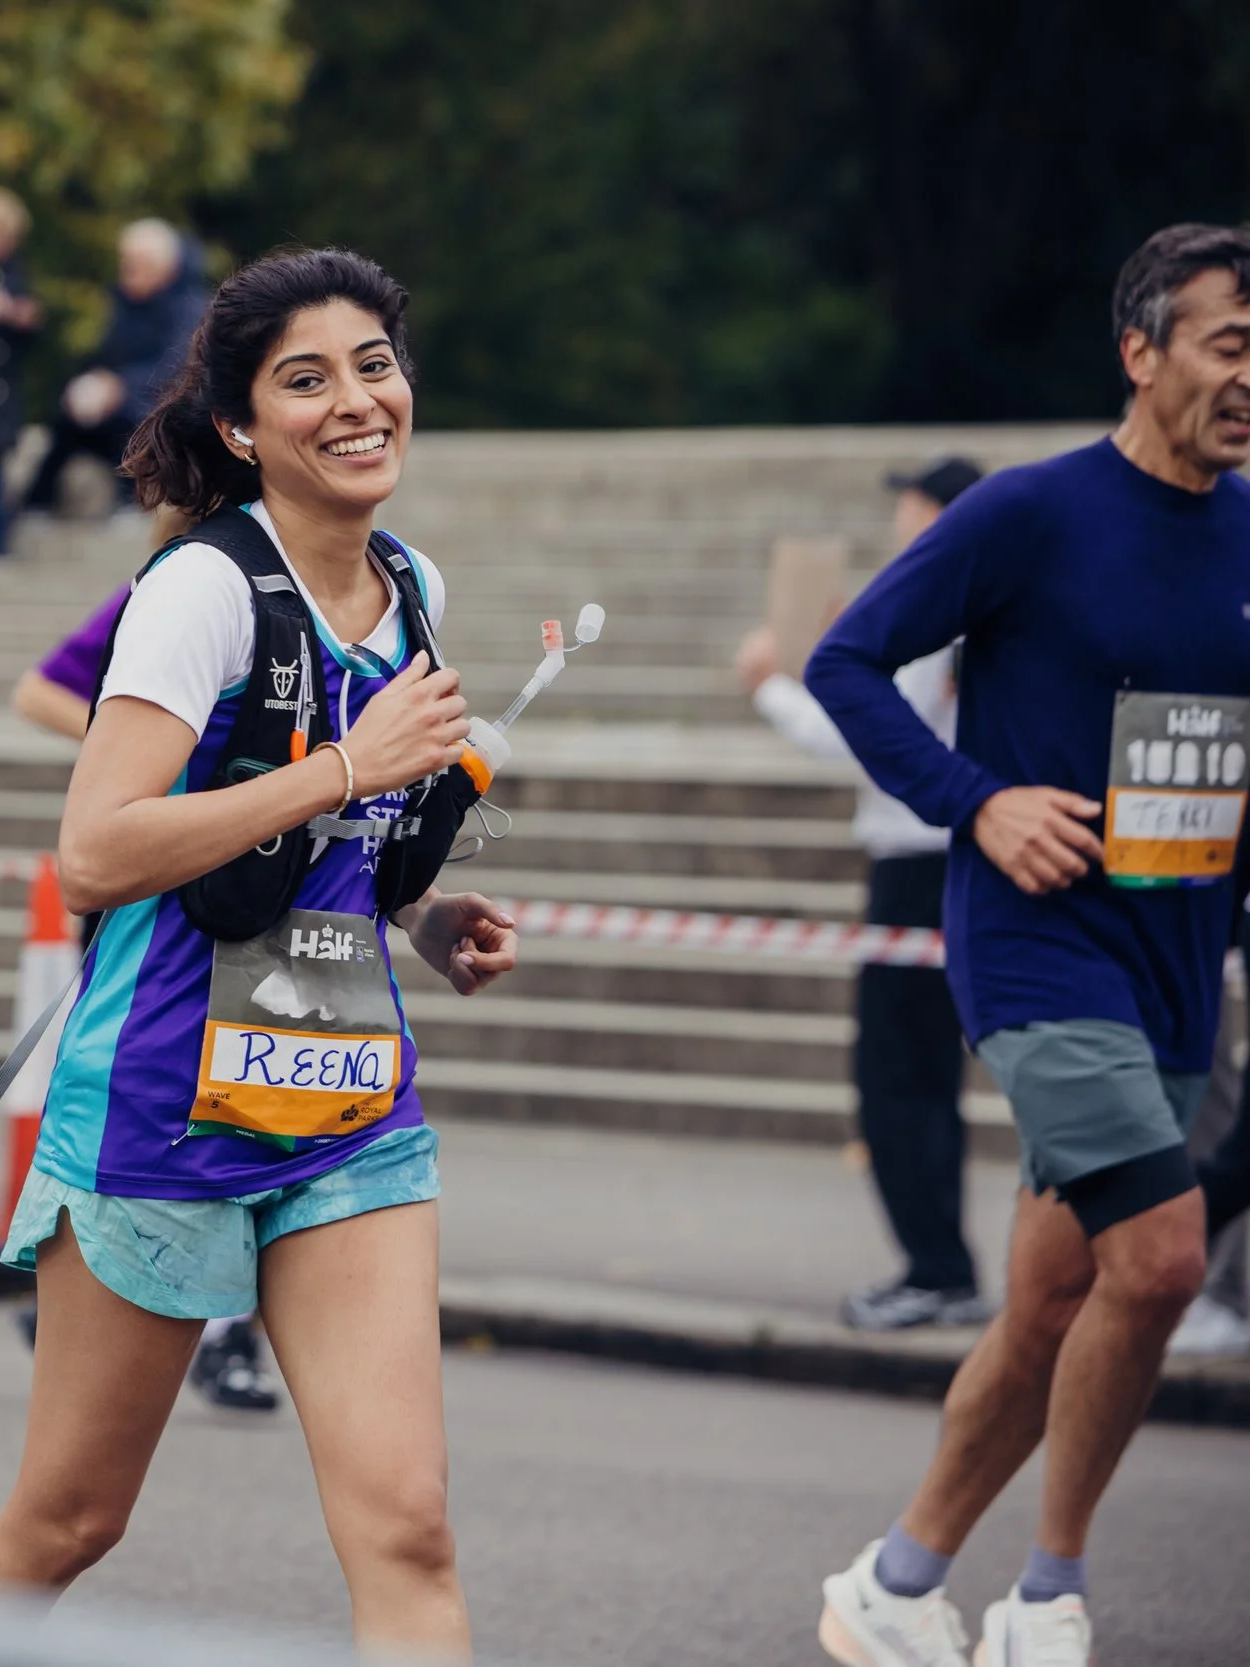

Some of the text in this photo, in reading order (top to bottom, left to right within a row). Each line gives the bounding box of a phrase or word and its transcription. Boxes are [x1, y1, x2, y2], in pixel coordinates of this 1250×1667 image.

[264, 699, 299, 711] UTOBEST
[290, 928, 353, 961] Half
[207, 1090, 231, 1100] WAVE
[210, 1100, 219, 1109] 5
[360, 1107, 382, 1115] ROYAL
